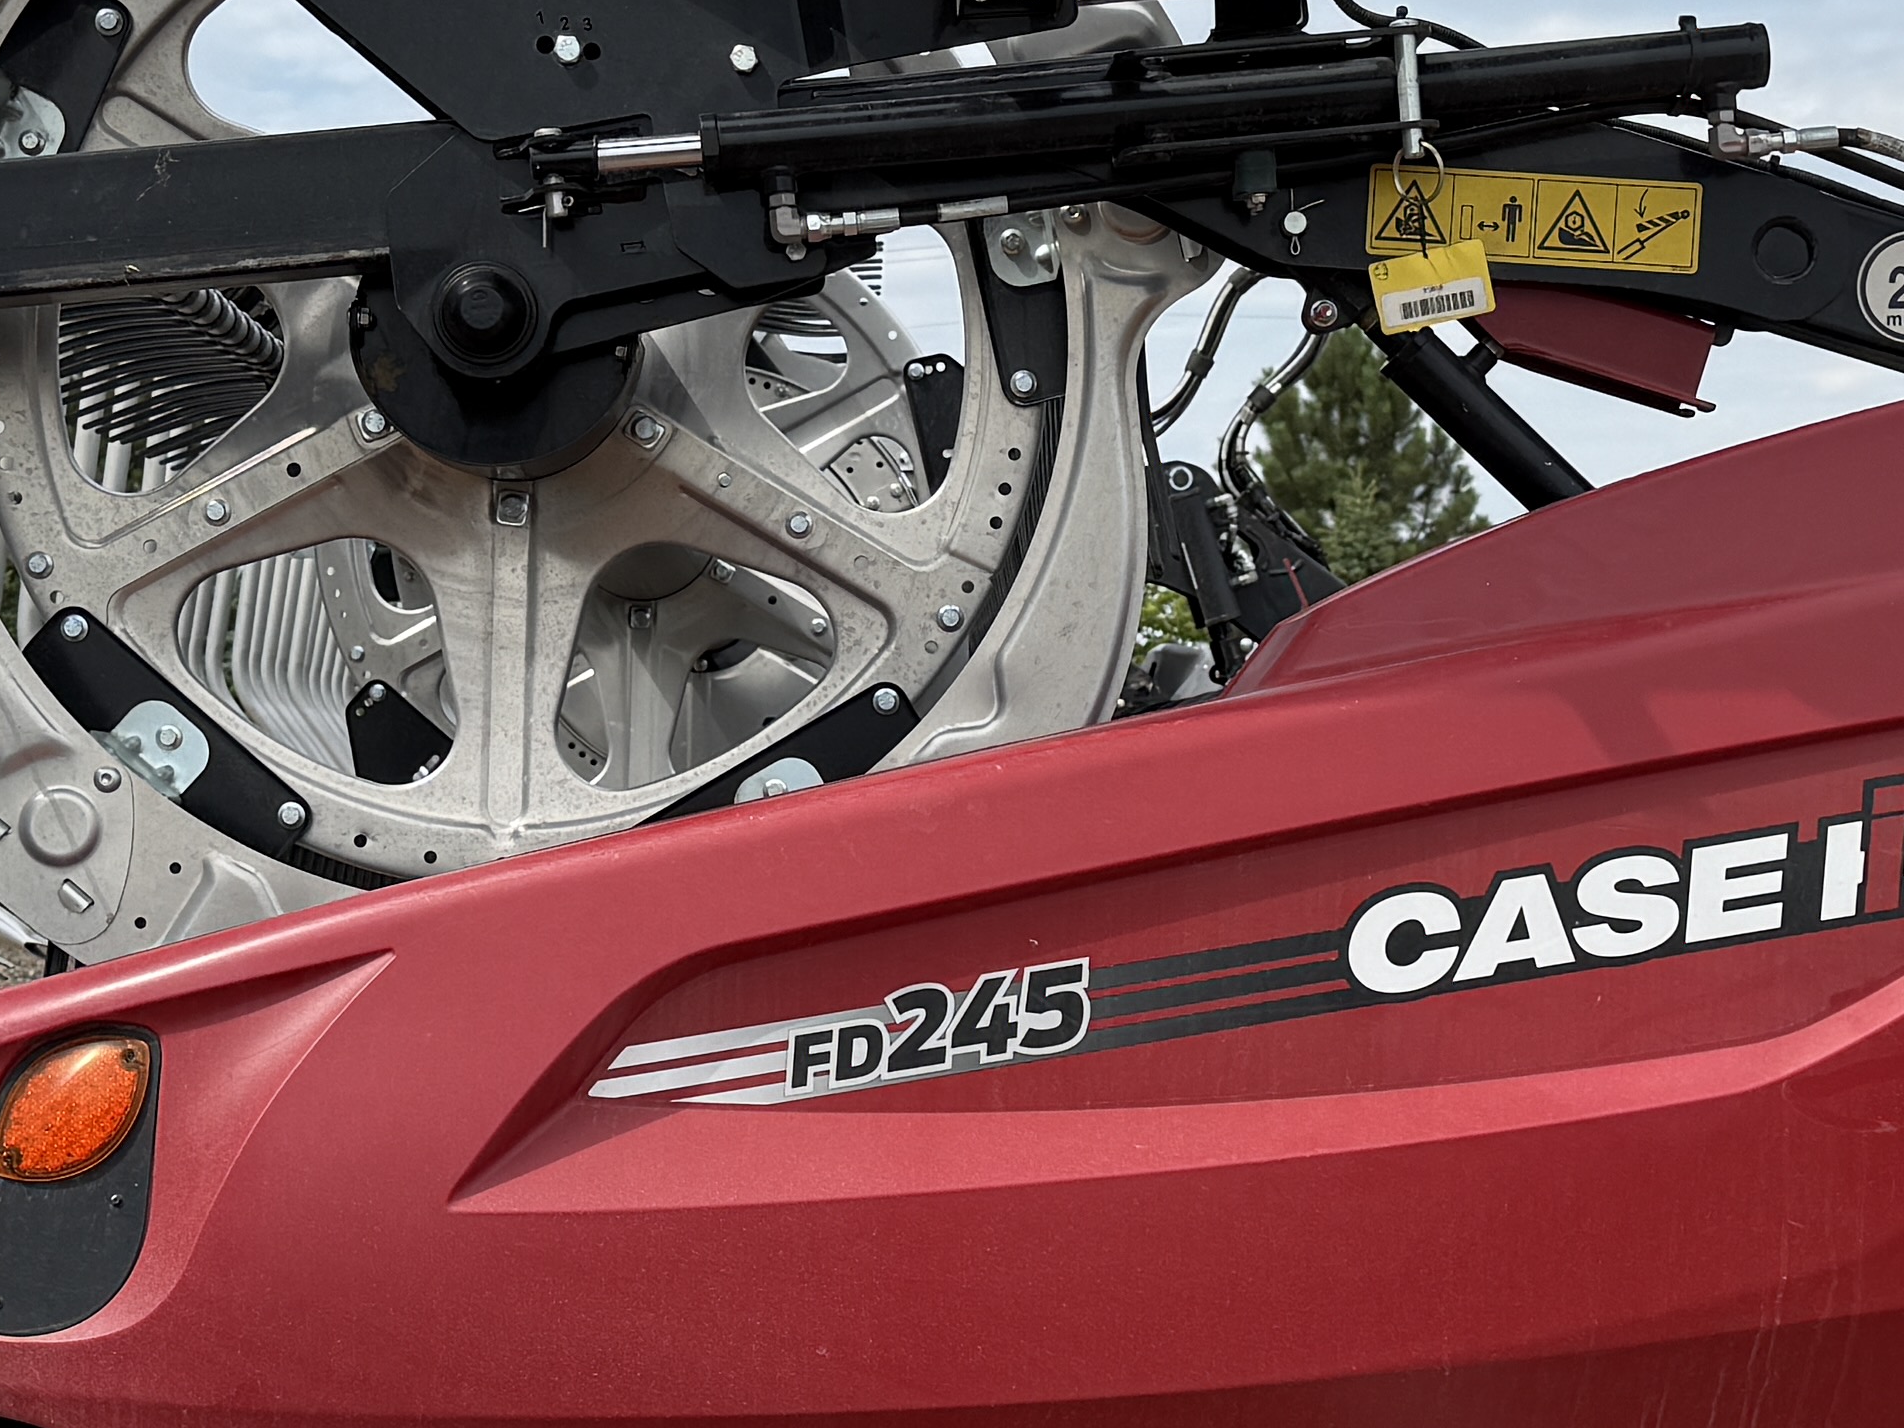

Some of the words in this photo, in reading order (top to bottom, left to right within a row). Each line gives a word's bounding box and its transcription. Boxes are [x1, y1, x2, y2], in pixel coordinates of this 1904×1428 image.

[536, 11, 544, 25] 1
[560, 17, 570, 31] 2
[583, 17, 593, 31] 3
[1346, 832, 1790, 994] CASE
[787, 958, 1091, 1095] FD245
